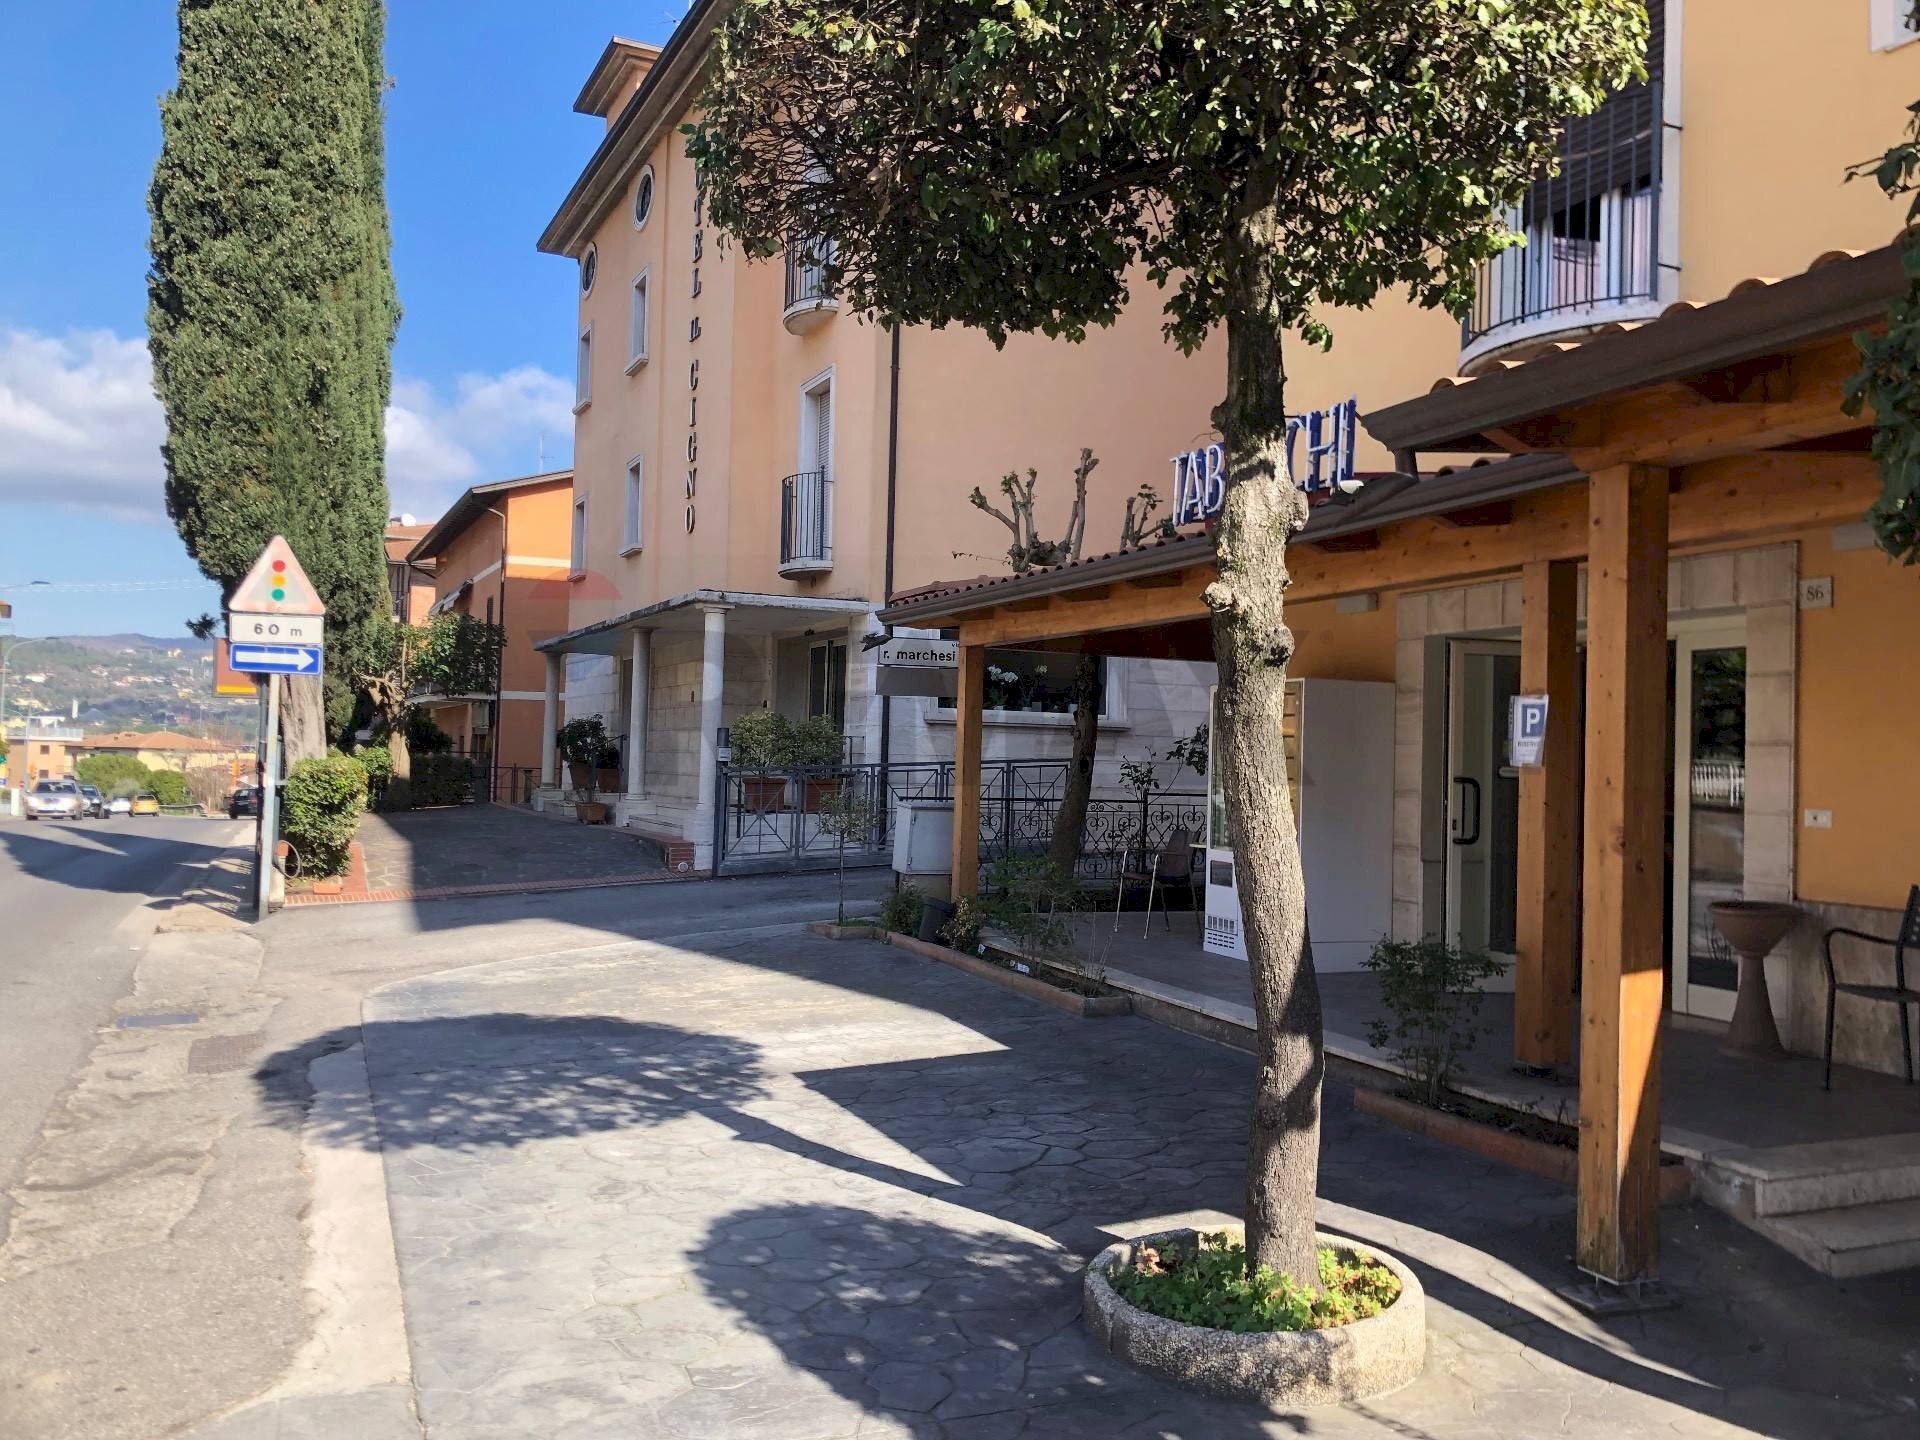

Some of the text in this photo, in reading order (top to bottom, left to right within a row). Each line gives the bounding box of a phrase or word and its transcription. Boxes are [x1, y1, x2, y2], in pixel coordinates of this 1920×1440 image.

[683, 359, 701, 534] CIGNO
[1169, 398, 1358, 528] TABCHI
[253, 623, 303, 637] 60 m
[883, 649, 956, 662] r. marchesi
[1526, 707, 1541, 734] P
